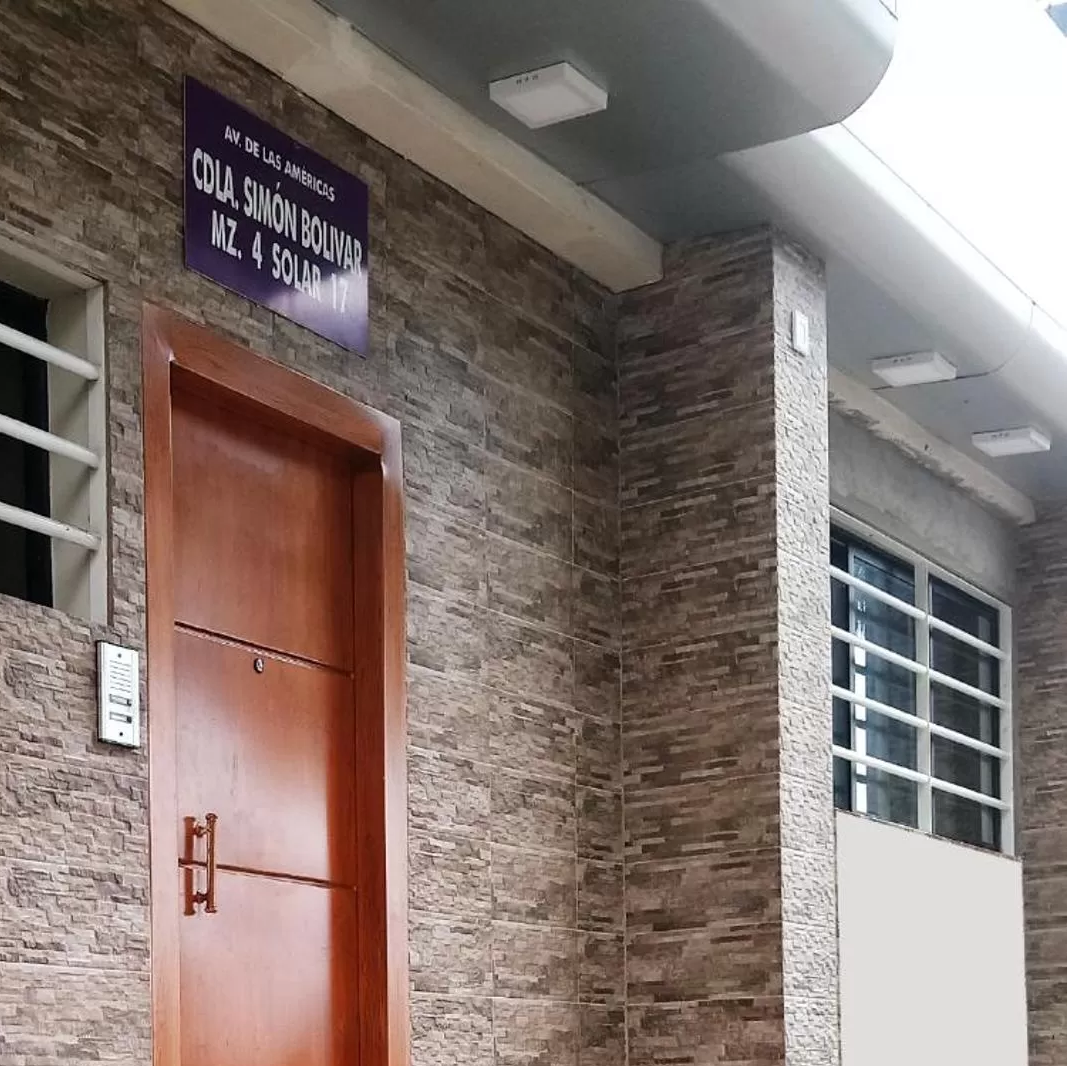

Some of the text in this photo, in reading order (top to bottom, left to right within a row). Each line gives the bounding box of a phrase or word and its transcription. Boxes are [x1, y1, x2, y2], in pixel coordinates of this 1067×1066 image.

[224, 125, 242, 149] AV.
[245, 136, 260, 158] DE
[262, 146, 282, 171] LAS
[192, 147, 362, 277] CDLA. SIMÓN BOLIVAR
[211, 209, 348, 313] MZ. 4 SOLAR 17
